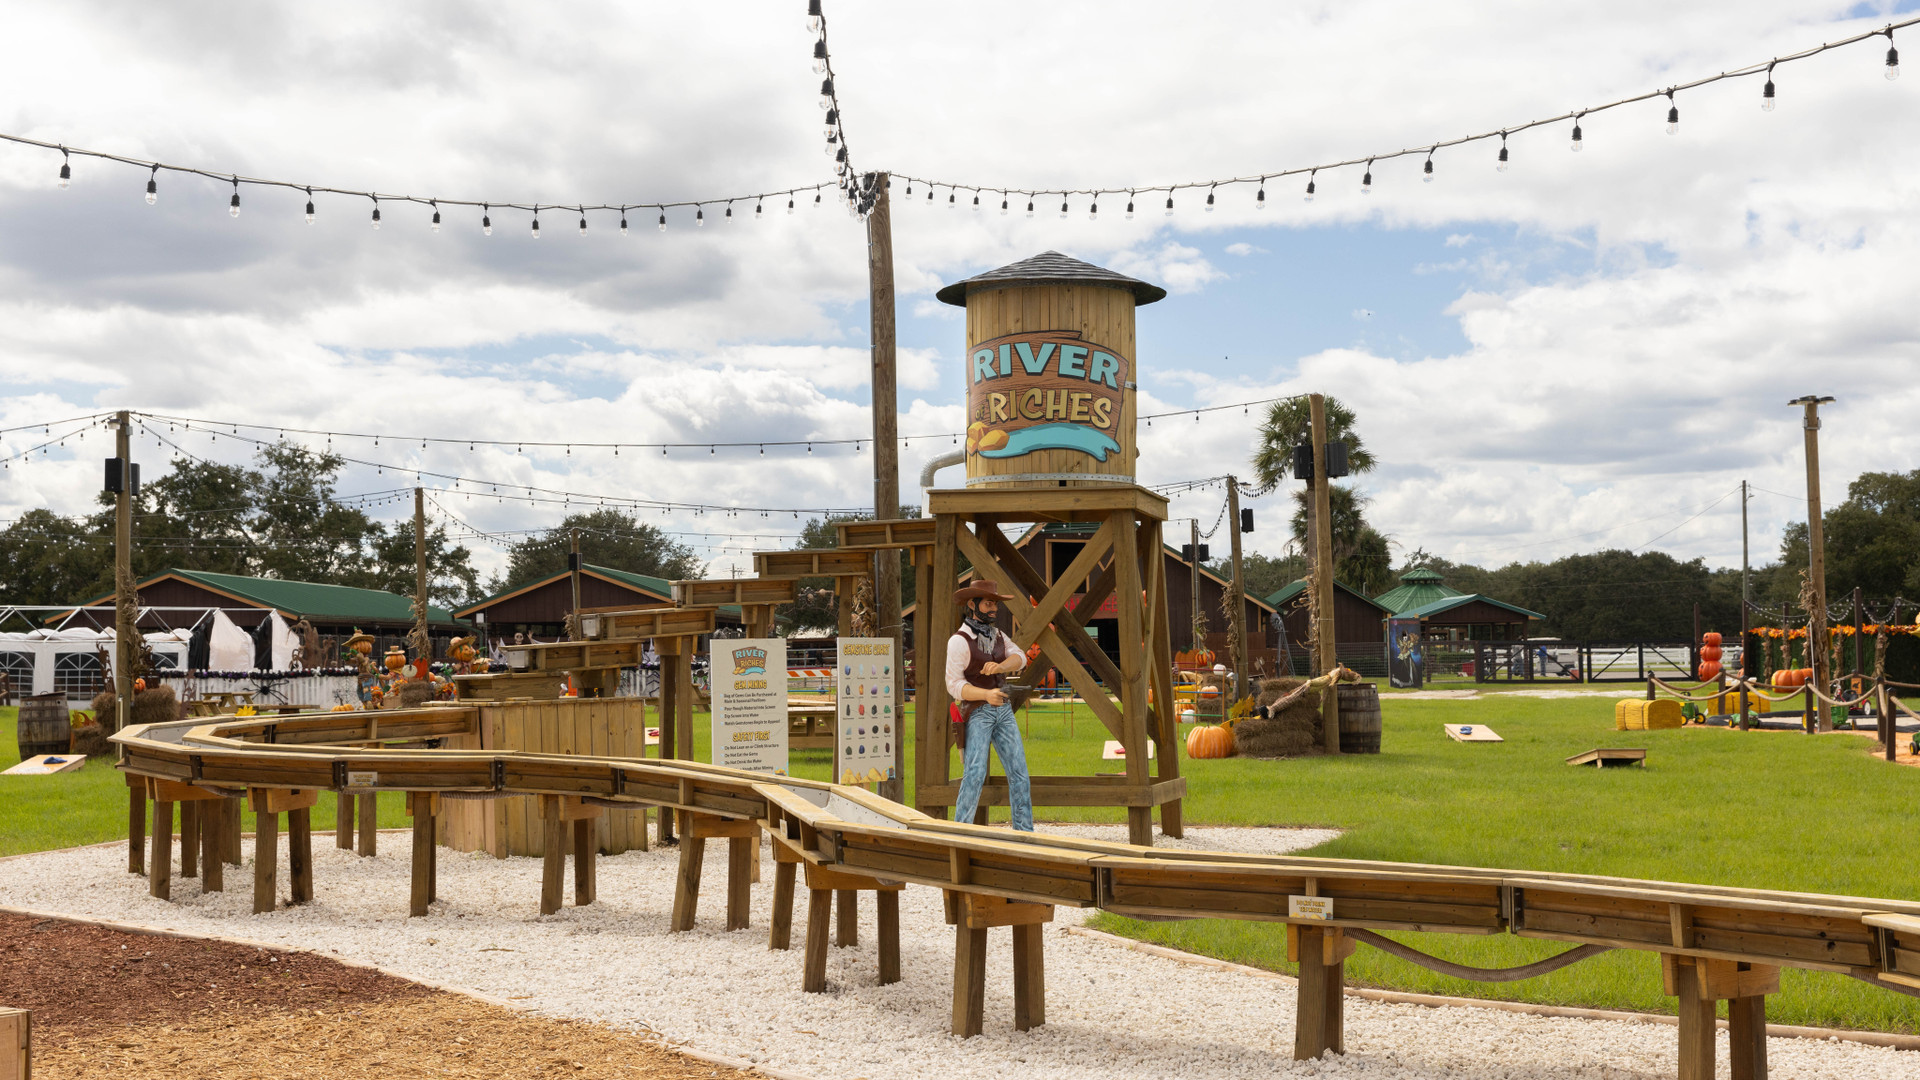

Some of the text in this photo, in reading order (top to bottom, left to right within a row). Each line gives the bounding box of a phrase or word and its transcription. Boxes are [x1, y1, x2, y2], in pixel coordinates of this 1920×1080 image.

[972, 342, 1120, 392] RIVER
[986, 388, 1113, 430] RICHES
[736, 650, 765, 659] RIVER
[843, 644, 890, 655] GEMSTONE CHART
[740, 660, 765, 668] RICHES
[734, 680, 767, 690] GEM MINING
[733, 730, 770, 742] SAFETY FIRST
